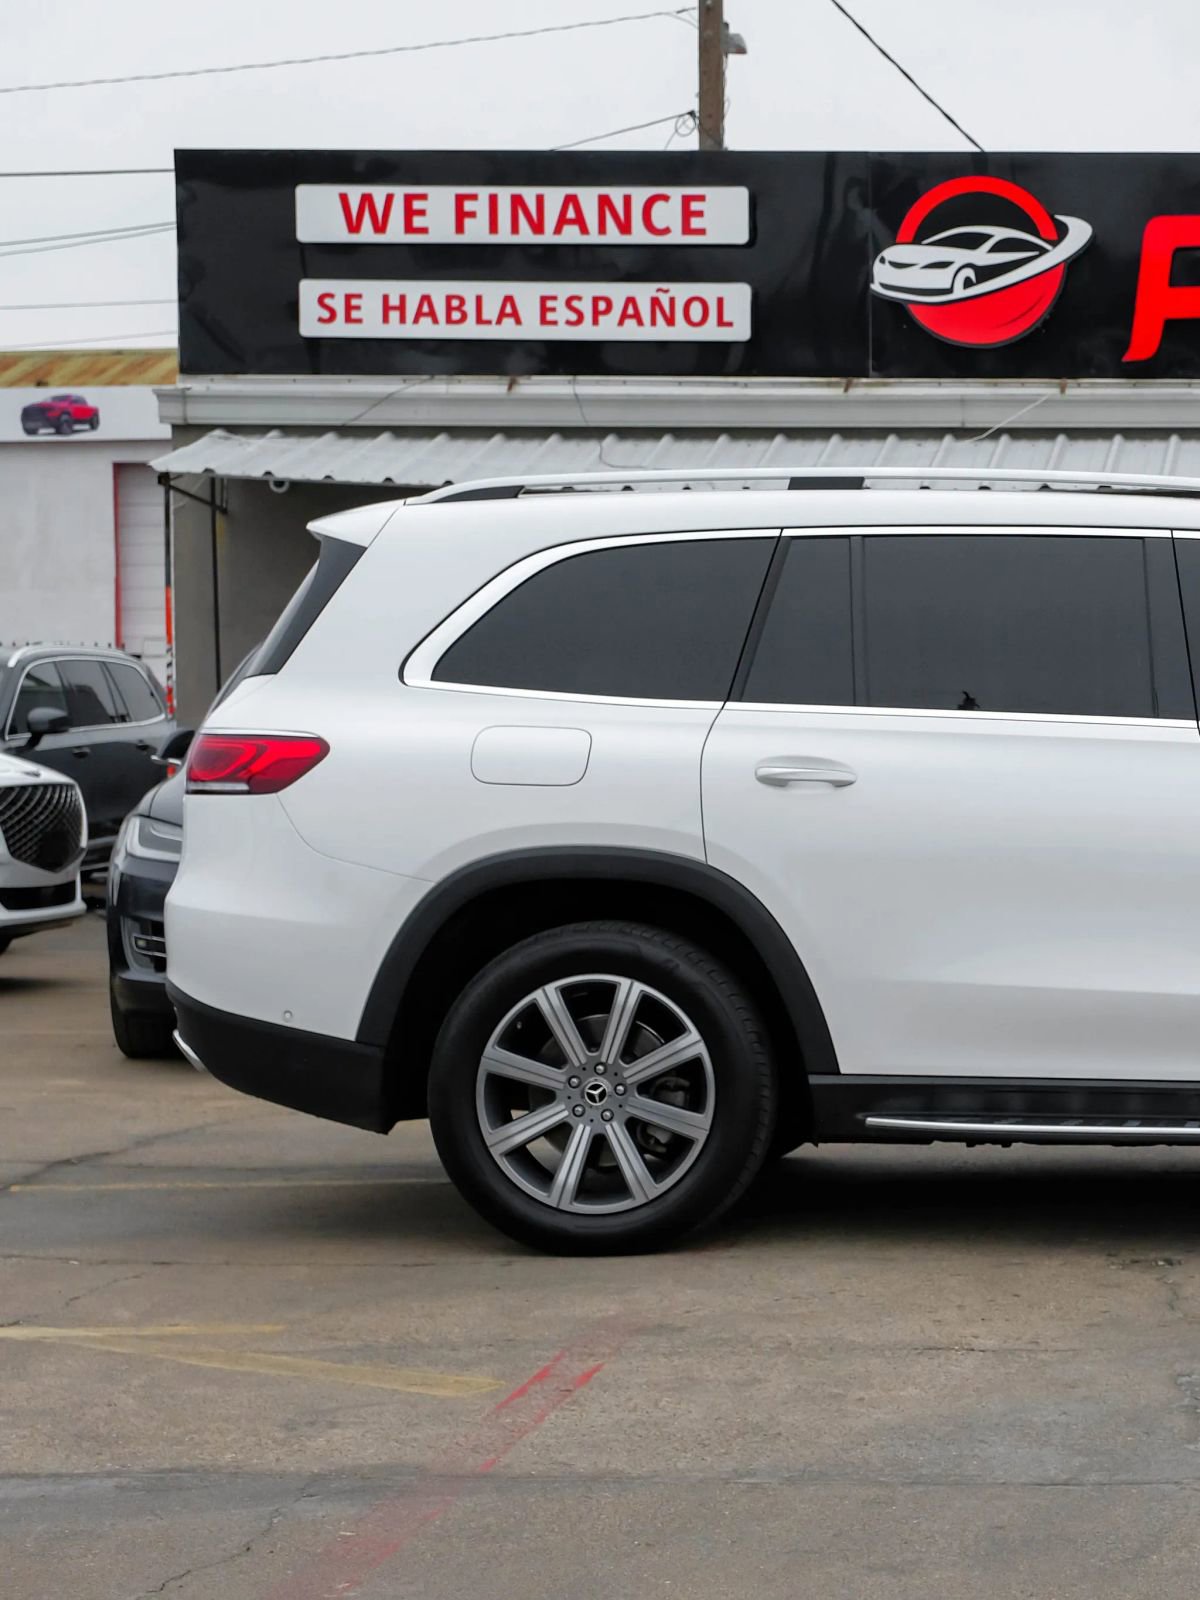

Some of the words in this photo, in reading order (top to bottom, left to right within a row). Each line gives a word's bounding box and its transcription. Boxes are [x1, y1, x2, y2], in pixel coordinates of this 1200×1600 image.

[338, 191, 430, 236] WE
[454, 192, 707, 237] FINANCE
[317, 292, 363, 325] SE
[382, 293, 523, 327] HABLA
[539, 287, 733, 329] ESPAÑOL
